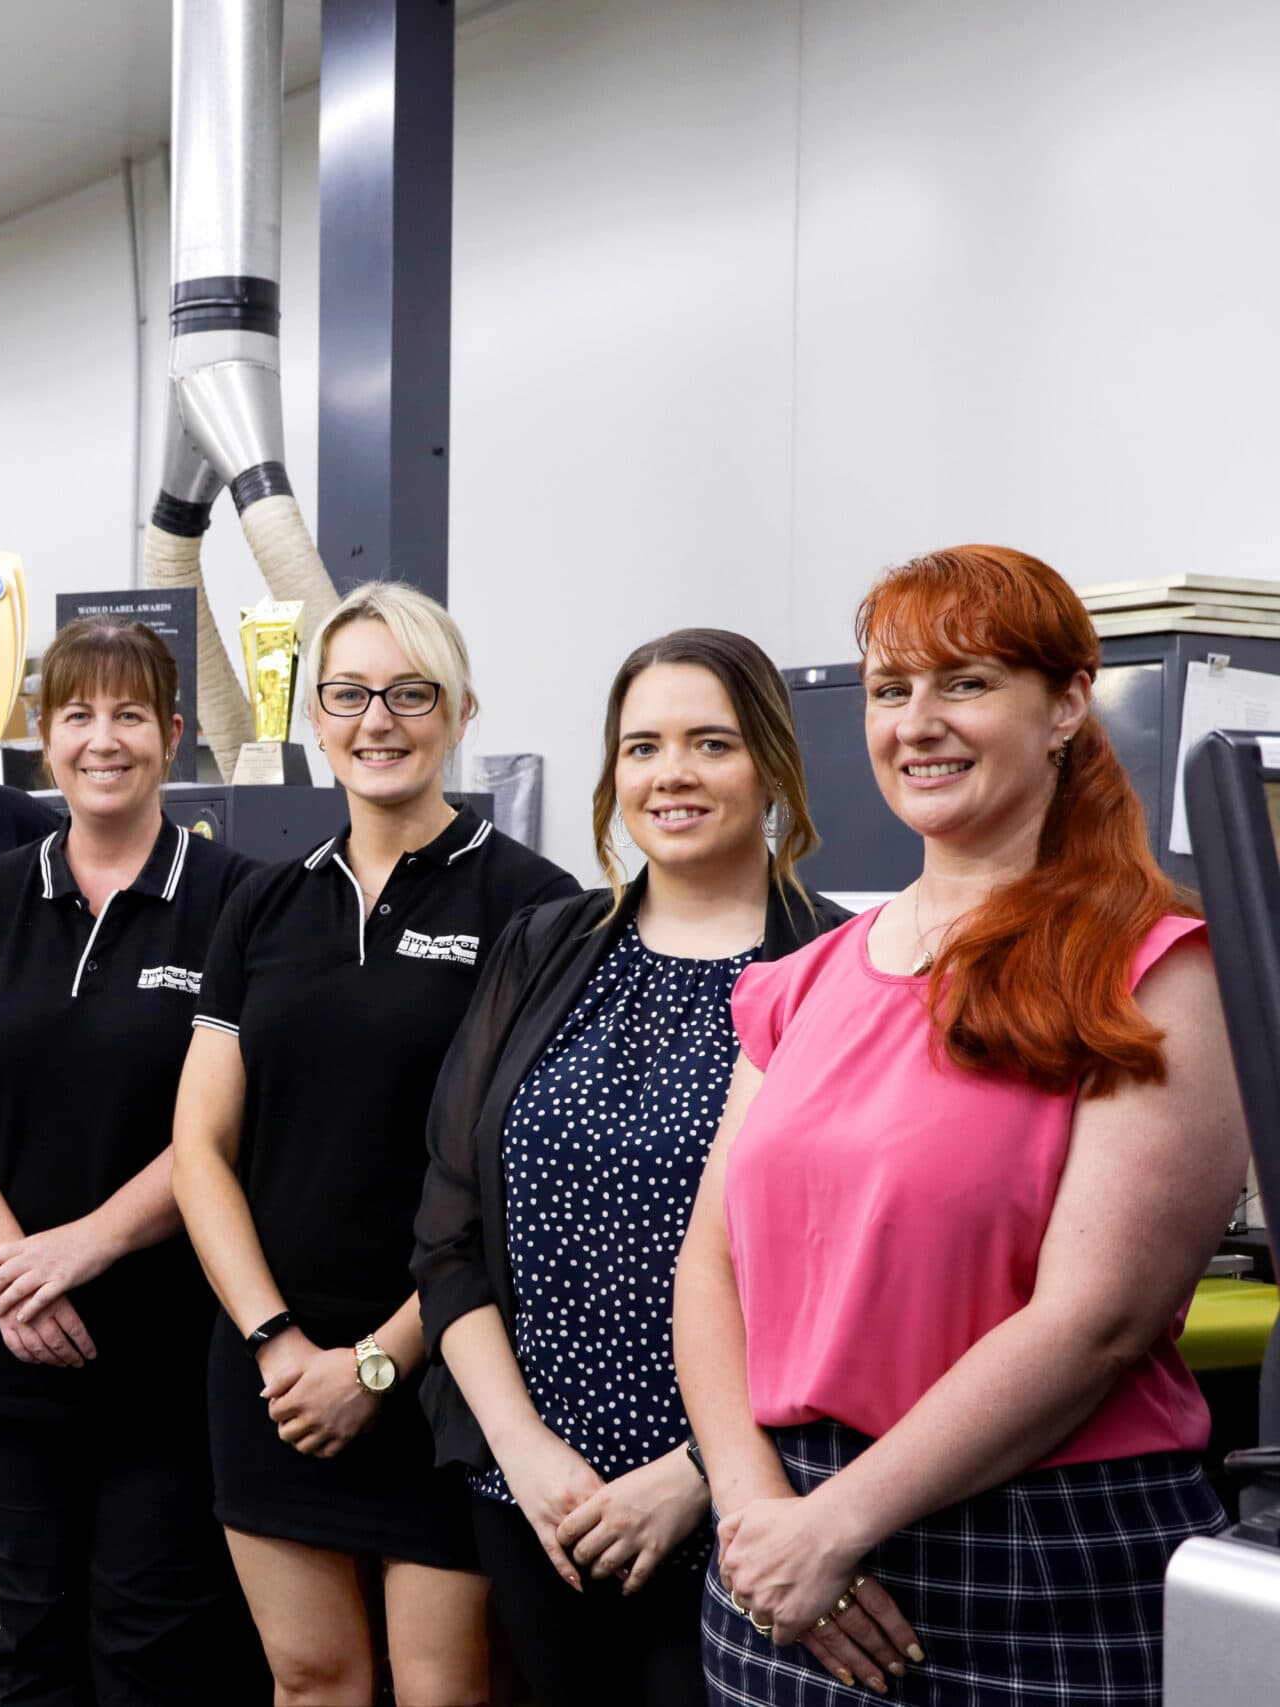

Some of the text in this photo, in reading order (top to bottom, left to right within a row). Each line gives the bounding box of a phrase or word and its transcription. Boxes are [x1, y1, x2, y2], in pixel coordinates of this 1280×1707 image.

[78, 603, 172, 614] WORLD LABEL AWARDS
[440, 954, 476, 966] SOLUTIONS
